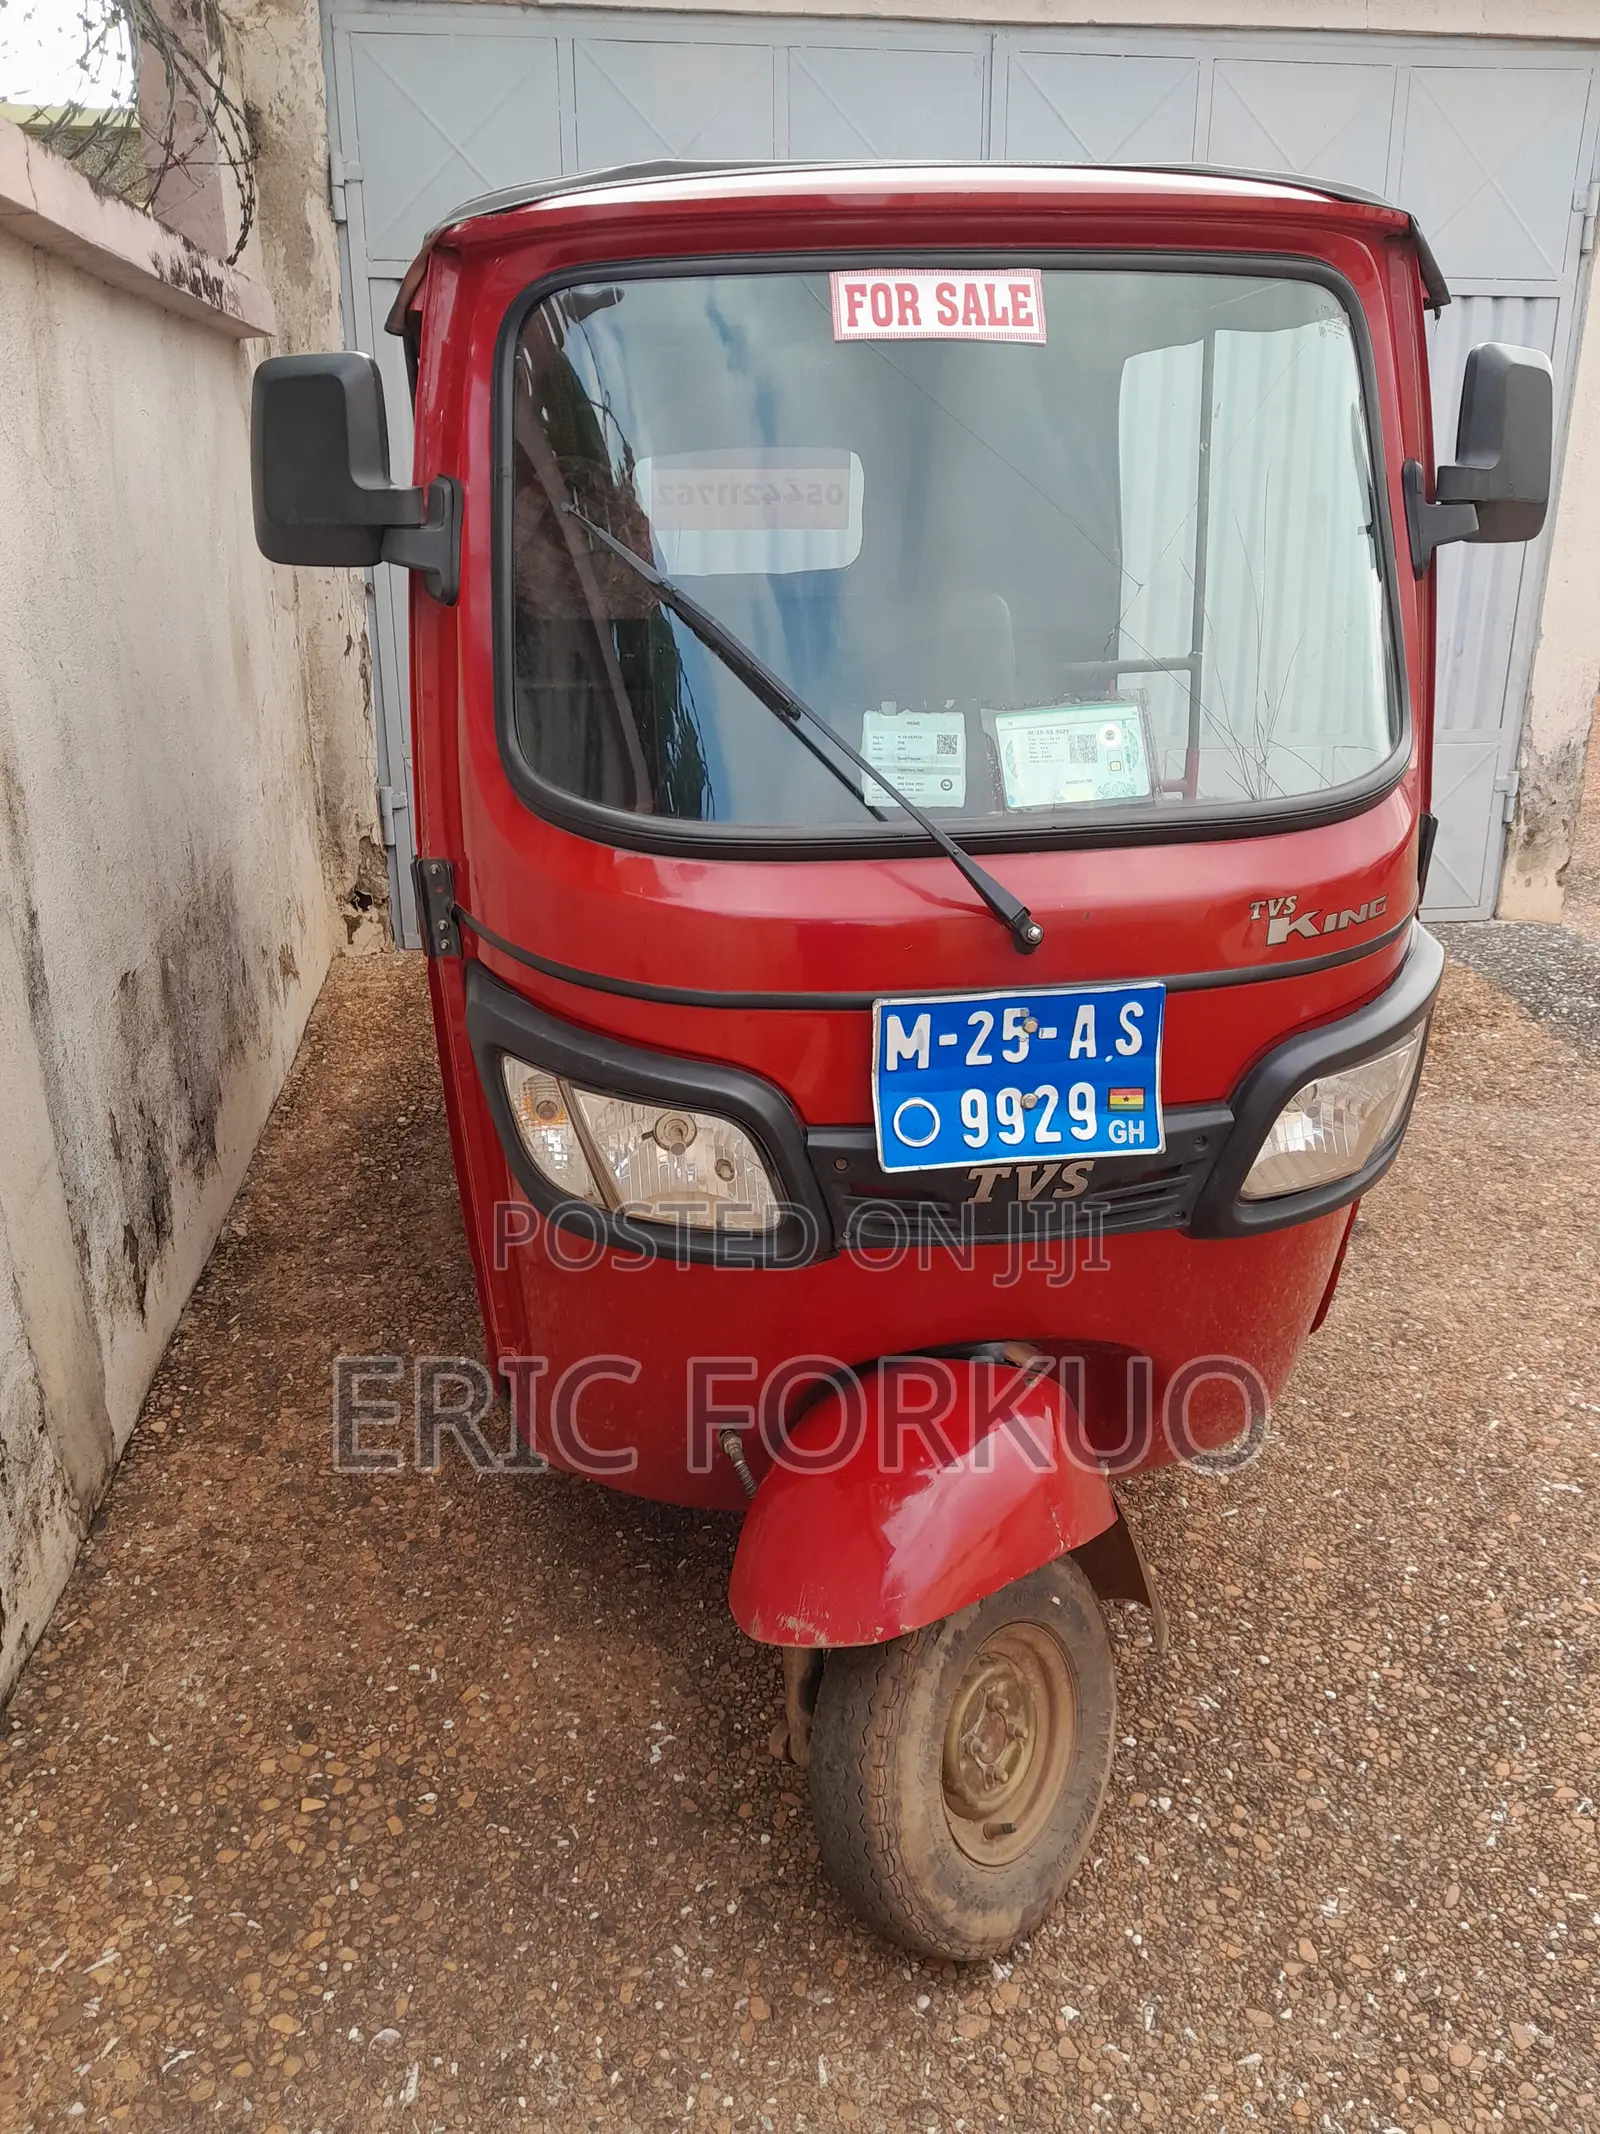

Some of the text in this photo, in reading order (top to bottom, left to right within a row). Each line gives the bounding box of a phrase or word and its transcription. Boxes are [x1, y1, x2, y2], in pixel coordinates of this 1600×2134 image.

[844, 282, 1034, 327] FOR SALE
[1249, 894, 1298, 920] TVS
[960, 1081, 1098, 1149] 9929
[1108, 1118, 1145, 1144] GH
[967, 1160, 1096, 1204] TVS
